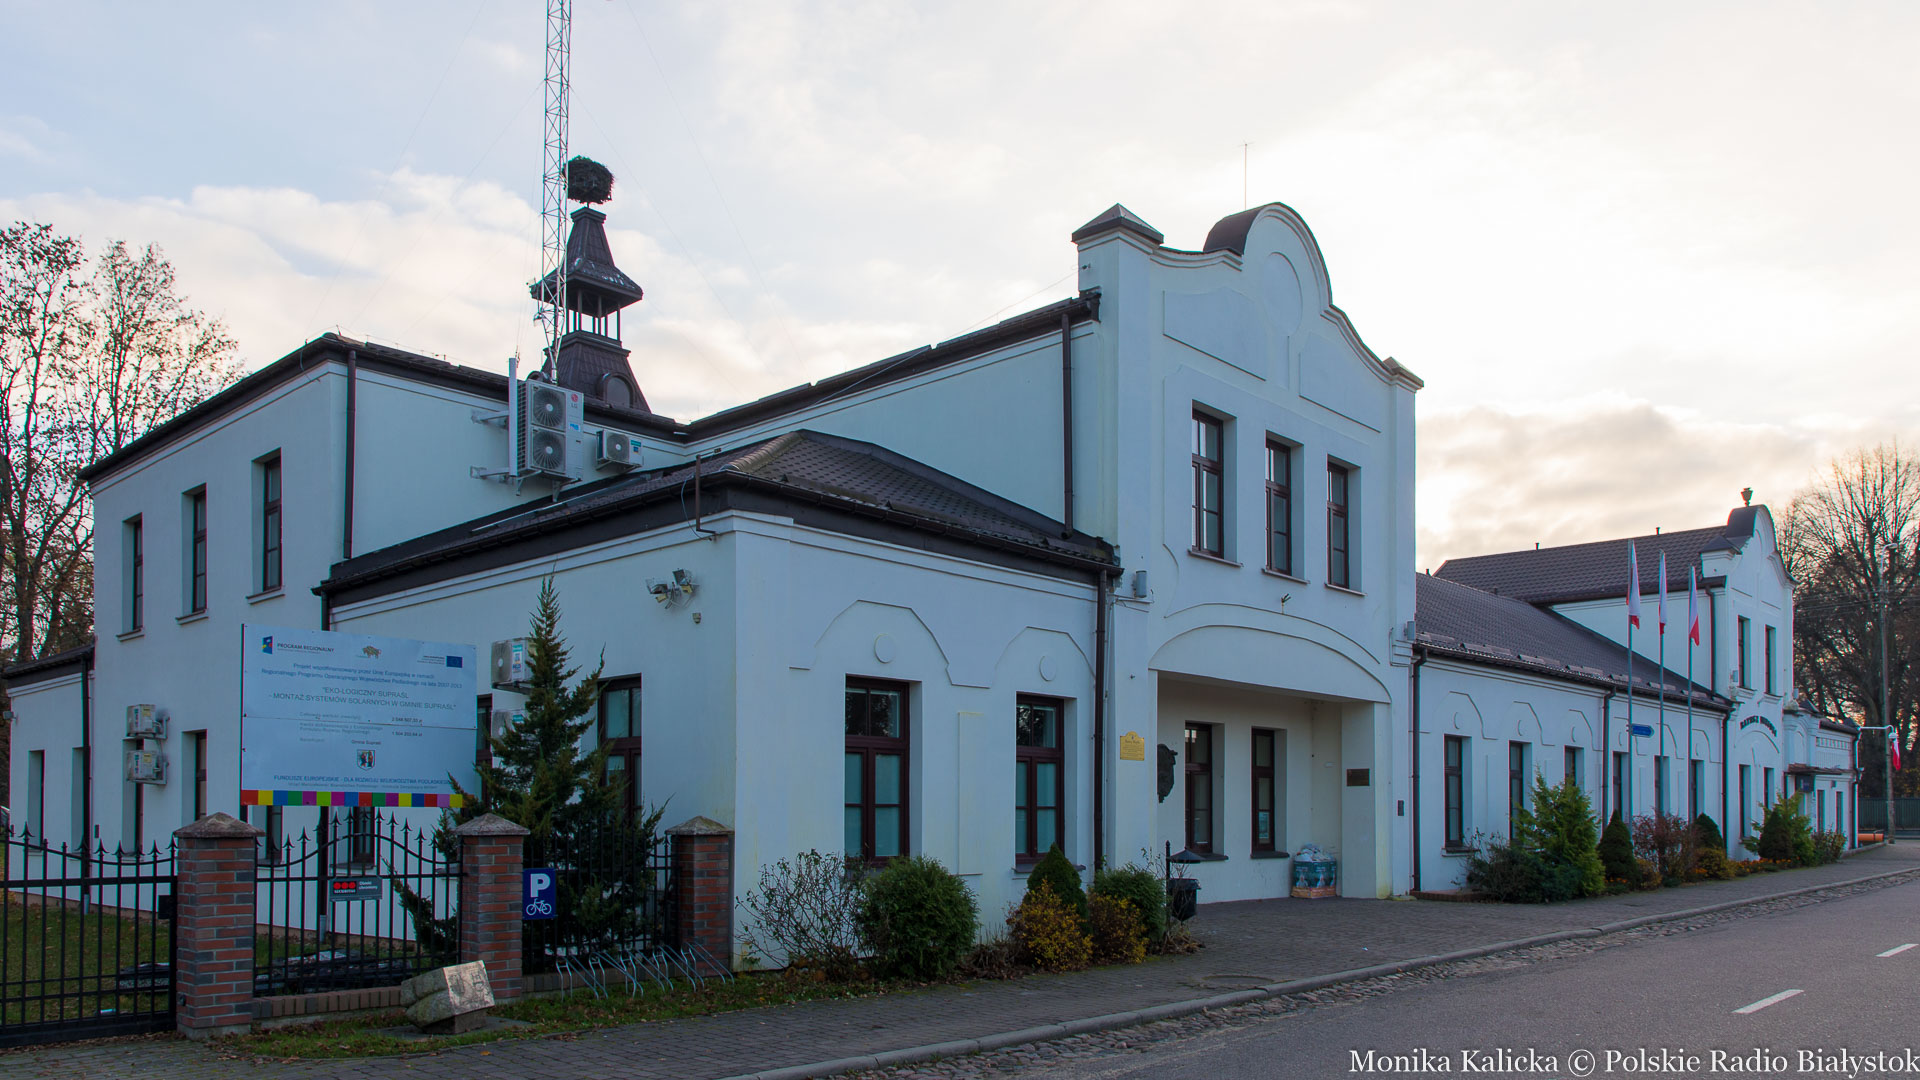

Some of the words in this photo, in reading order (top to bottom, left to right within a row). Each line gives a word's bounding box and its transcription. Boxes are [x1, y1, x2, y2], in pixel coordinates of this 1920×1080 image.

[305, 694, 347, 703] SYSTEMÓW
[348, 698, 390, 706] SOLARNYCH
[530, 873, 550, 897] P
